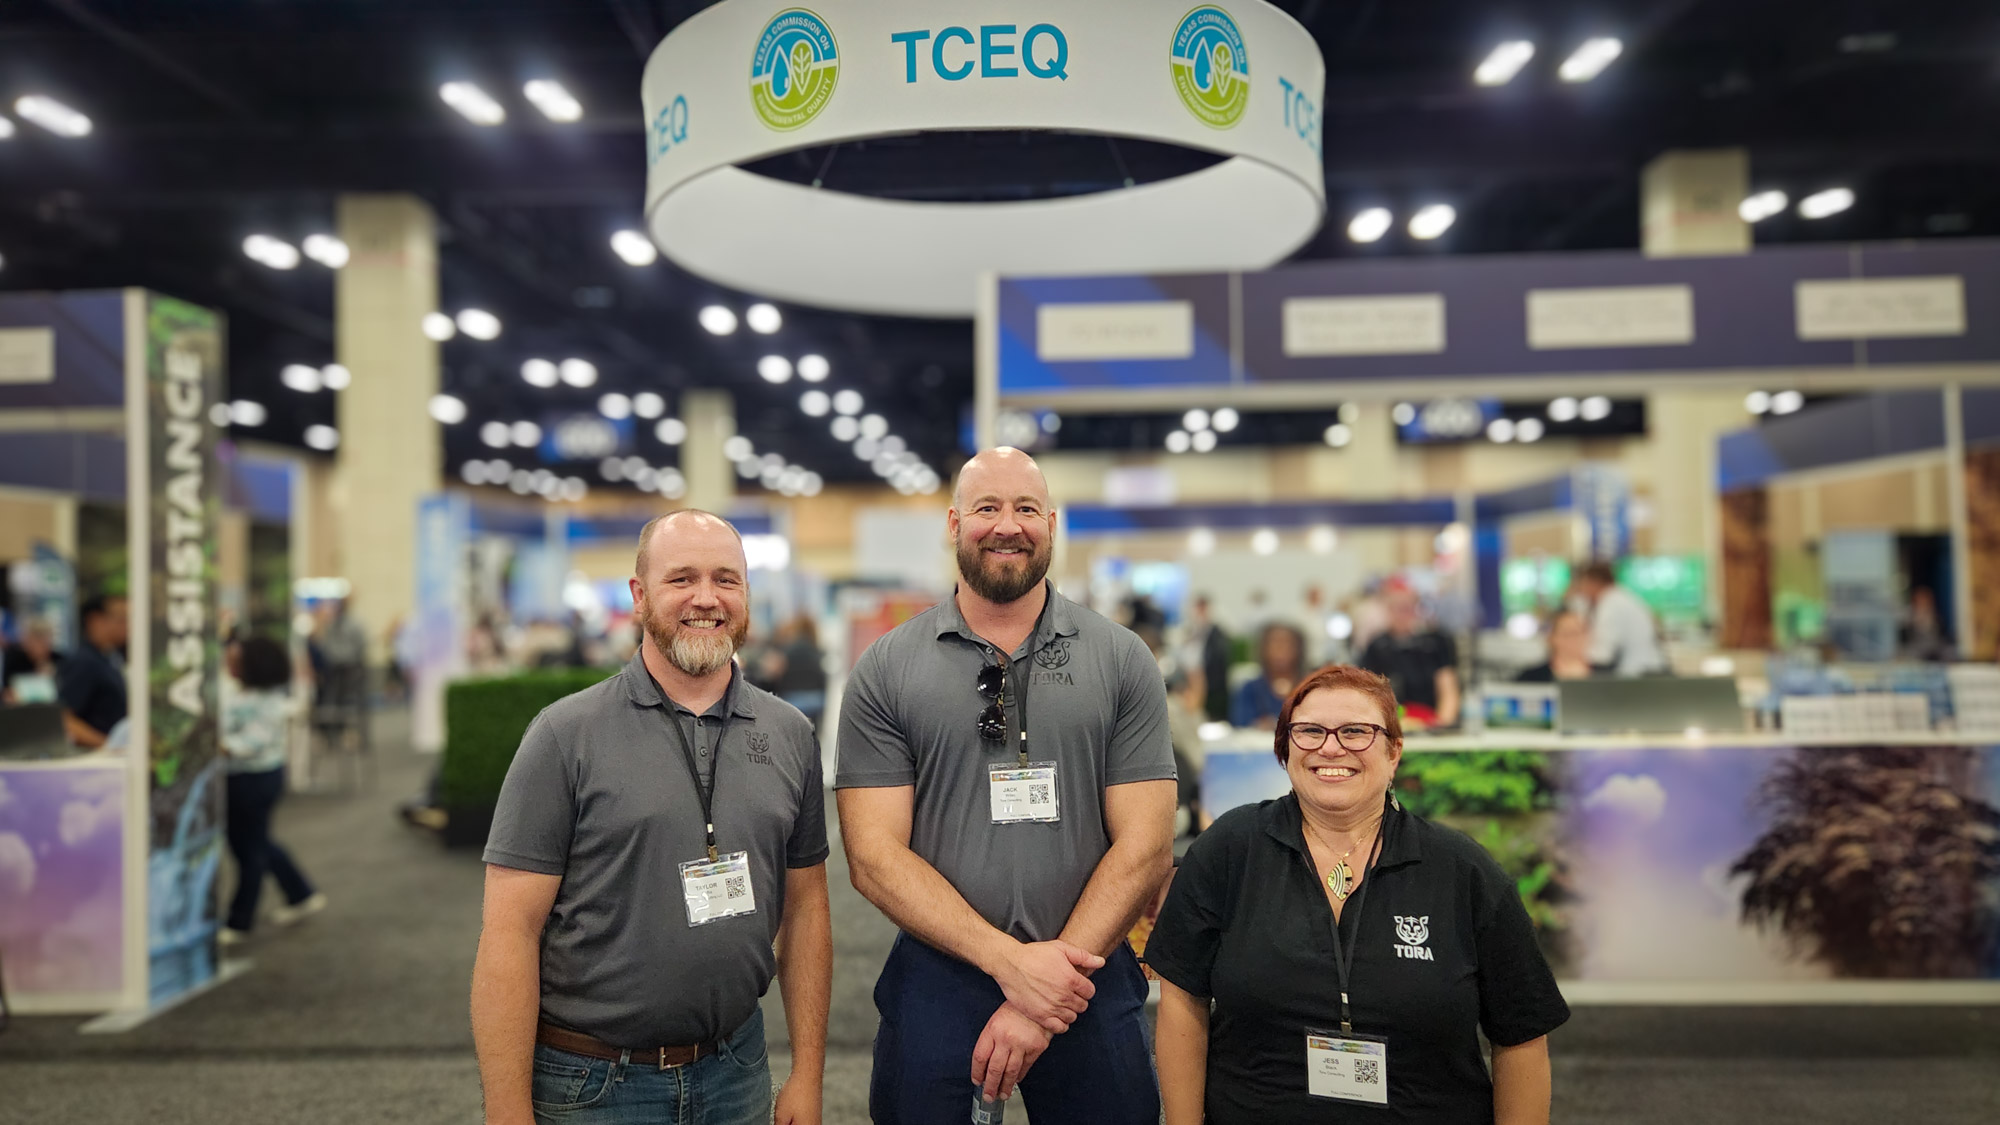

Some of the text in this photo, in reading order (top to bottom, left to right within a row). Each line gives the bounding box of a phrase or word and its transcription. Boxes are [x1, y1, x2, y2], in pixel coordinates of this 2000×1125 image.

[756, 16, 831, 67] TEXAS COMMISSION ON
[1177, 19, 1198, 48] TEXAS
[891, 23, 1069, 84] TCEQ
[806, 77, 832, 114] QUALITY
[165, 347, 203, 716] ASSISTANCE
[1031, 672, 1074, 686] TORA
[746, 753, 774, 766] TORA
[695, 882, 718, 891] TAYLOR
[1393, 944, 1434, 961] TORA
[1322, 1057, 1340, 1065] JESS
